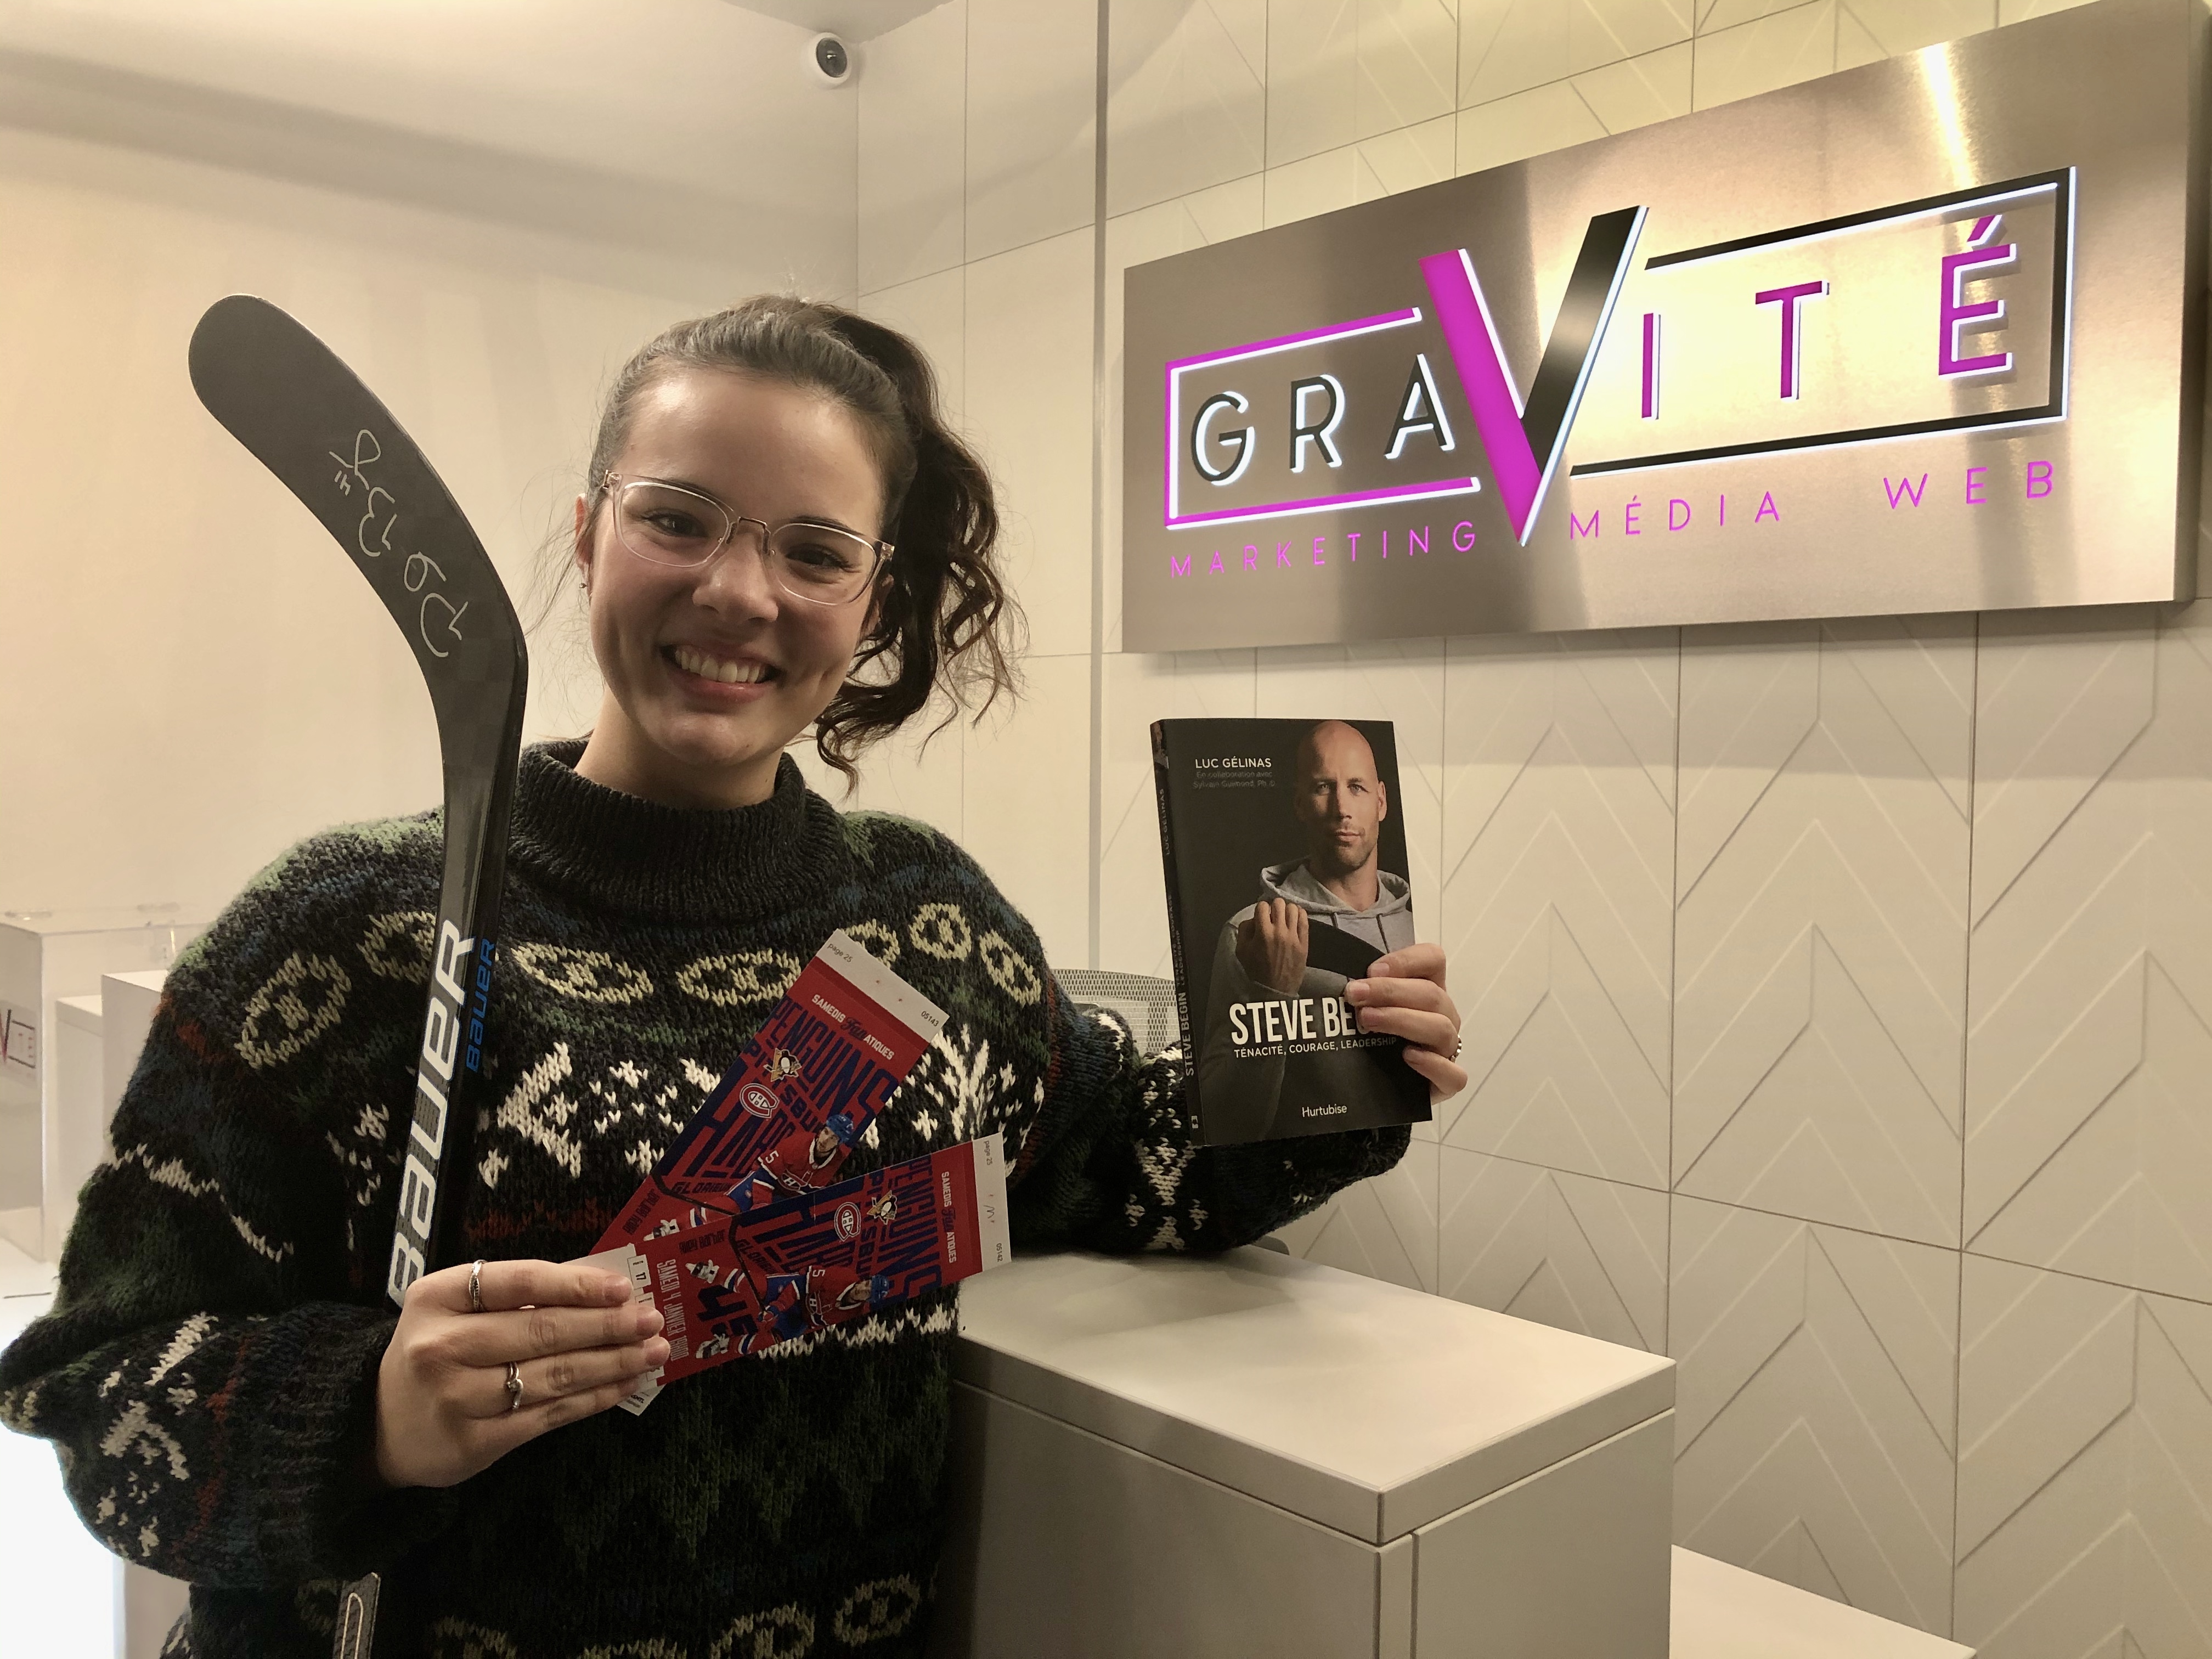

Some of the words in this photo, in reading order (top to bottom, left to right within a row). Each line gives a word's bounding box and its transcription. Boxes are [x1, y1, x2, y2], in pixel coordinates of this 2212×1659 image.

[1190, 205, 2017, 546] GRAVITÉ
[1170, 520, 1477, 578] MARKETING
[1570, 491, 1780, 540] MÉDIA
[1883, 460, 2053, 509] WEB
[1195, 758, 1219, 769] LUC
[1222, 757, 1272, 769] GÉLINAS
[827, 943, 844, 957] page
[843, 953, 854, 963] 25
[812, 994, 847, 1023] SAMEDIS
[921, 1010, 940, 1028] 05143
[1229, 998, 1317, 1045] STEVE
[1182, 1034, 1194, 1076] STEVE
[1234, 1044, 1286, 1058] TÉNACITÉ,
[1289, 1041, 1339, 1054] COURAGE,
[1340, 1037, 1397, 1049] LEADERSHIP
[1302, 1103, 1347, 1118] Hurtubise
[986, 1157, 992, 1166] 25
[941, 1171, 952, 1207] SAMEDIS
[656, 1259, 680, 1293] SAMEDI
[662, 1291, 682, 1302] 4
[663, 1302, 686, 1337] JANVIER
